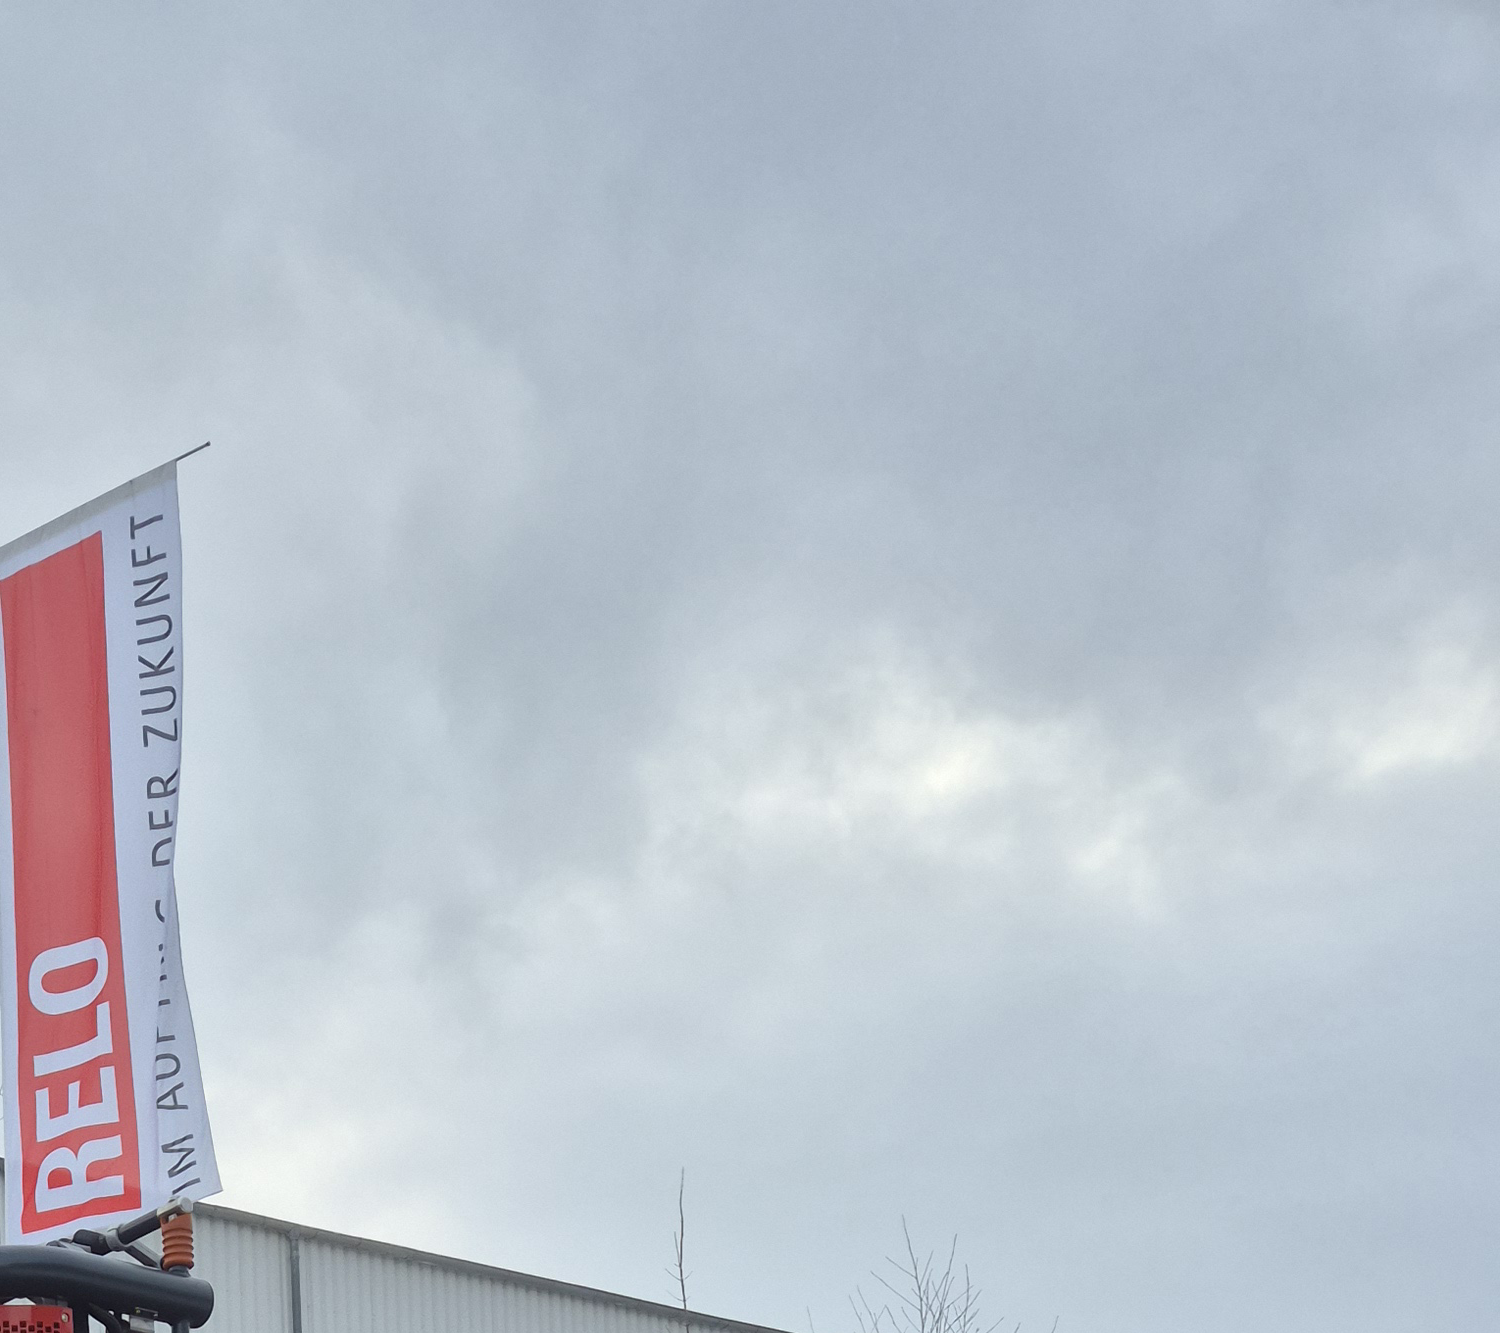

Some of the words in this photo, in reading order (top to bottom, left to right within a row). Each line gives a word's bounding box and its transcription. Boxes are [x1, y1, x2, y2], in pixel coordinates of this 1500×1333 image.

[130, 514, 178, 748] ZUKUNFT
[28, 936, 125, 1214] RELO
[161, 1133, 201, 1196] IM
